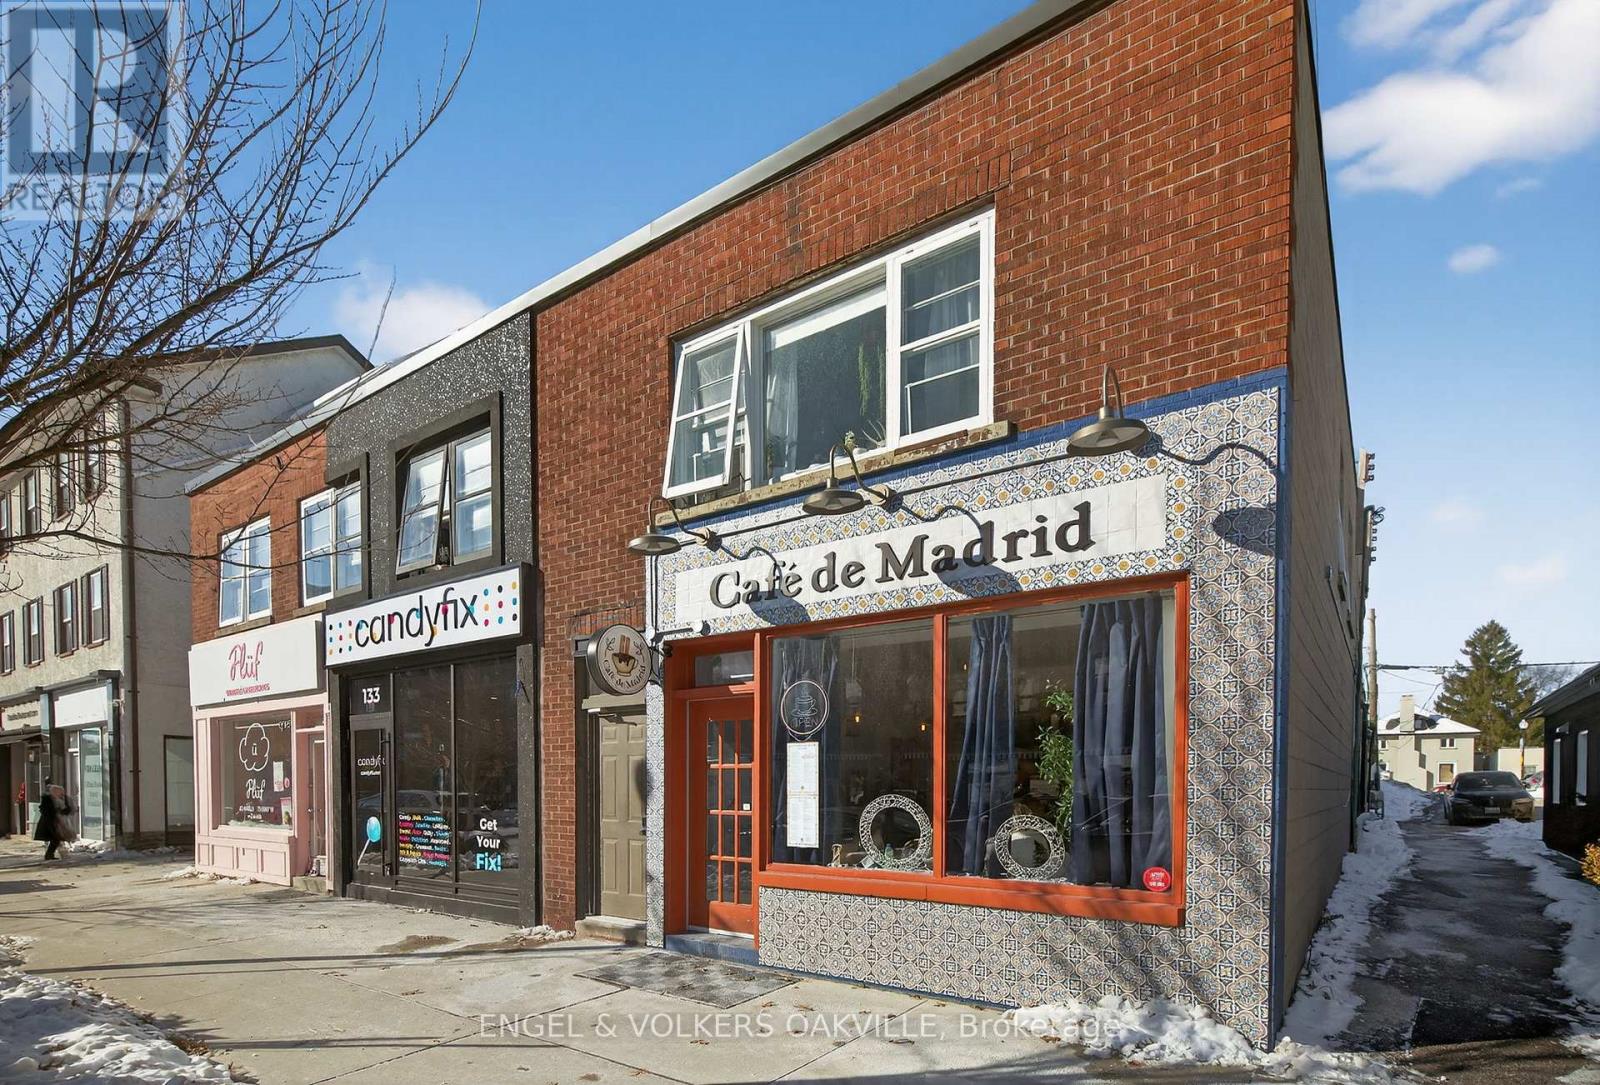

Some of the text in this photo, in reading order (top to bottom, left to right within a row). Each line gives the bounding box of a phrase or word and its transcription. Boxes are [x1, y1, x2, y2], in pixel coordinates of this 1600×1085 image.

[710, 500, 1097, 609] Café de Madrid
[354, 587, 479, 648] candyfix
[362, 687, 381, 704] 133
[479, 818, 498, 831] Get
[476, 835, 500, 848] Your
[476, 852, 502, 872] Fix!
